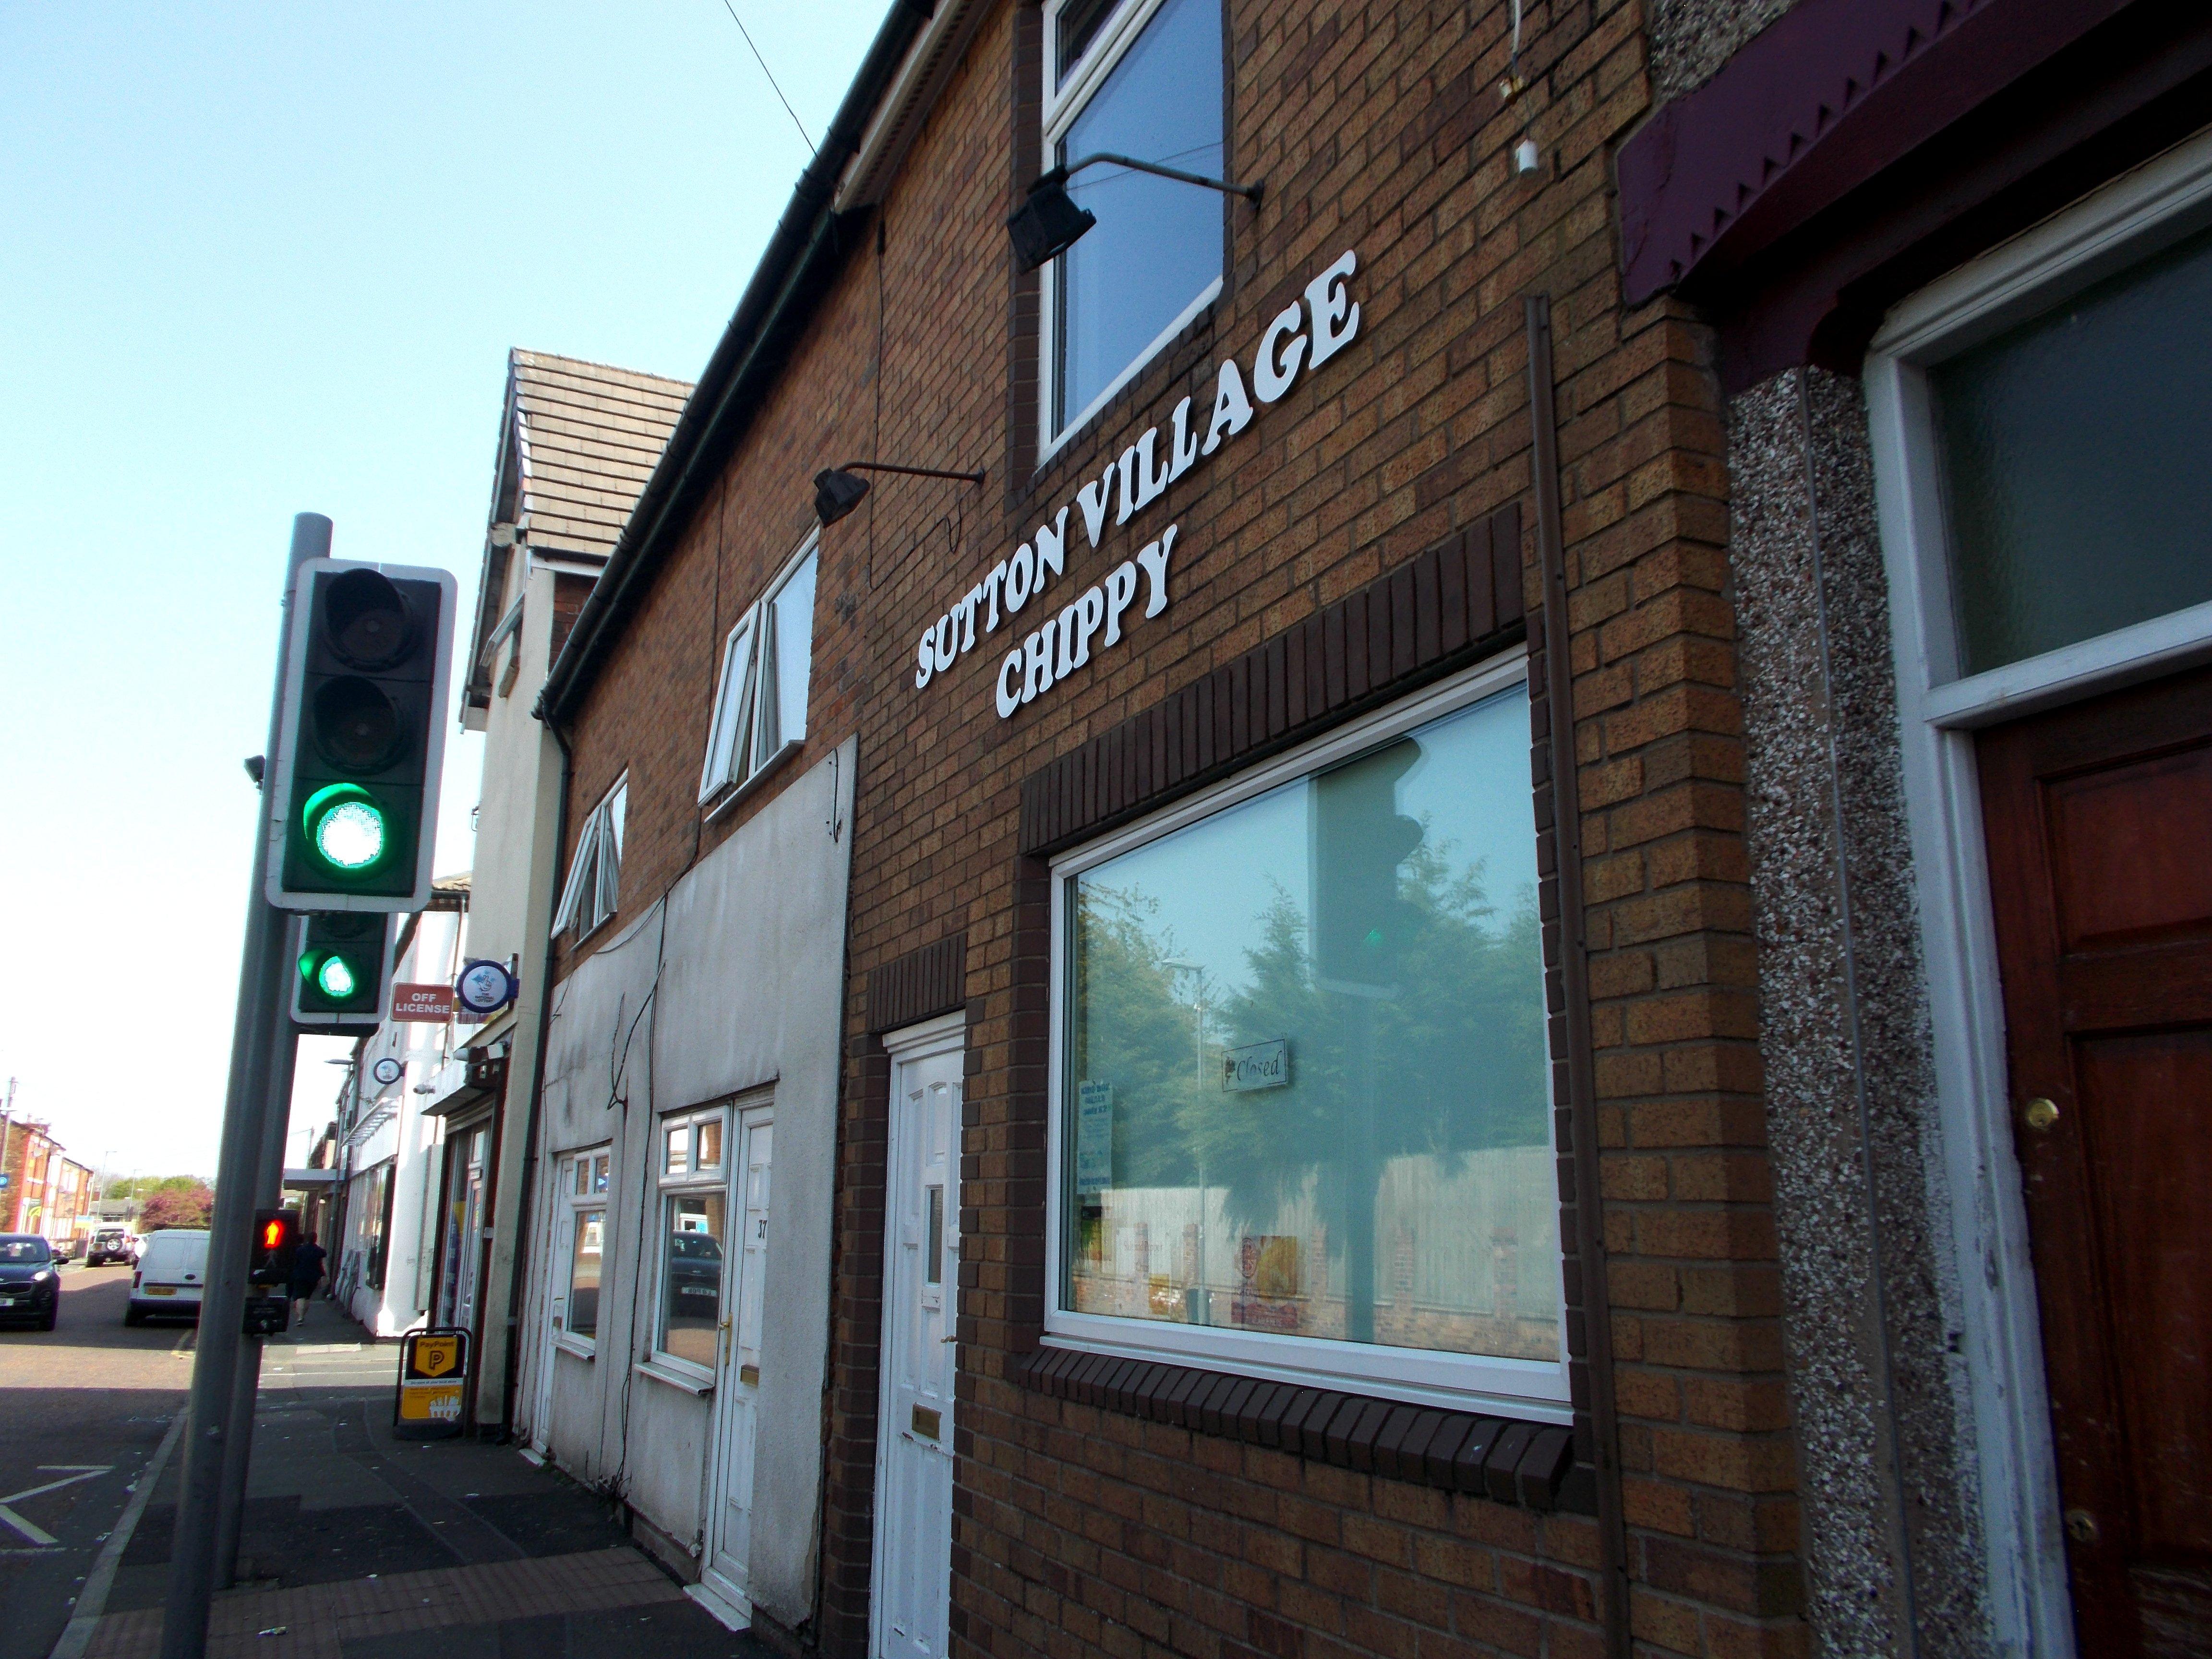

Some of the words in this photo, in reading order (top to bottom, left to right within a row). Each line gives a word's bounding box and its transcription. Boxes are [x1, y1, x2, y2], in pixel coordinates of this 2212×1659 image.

[915, 505, 1069, 689] SUTTON
[1076, 249, 1360, 548] VILLAGE
[996, 524, 1178, 719] CHIPPY
[395, 1002, 450, 1013] LICENSE
[412, 993, 436, 1002] OFF
[1237, 1050, 1283, 1081] Closed
[757, 1219, 767, 1239] 37
